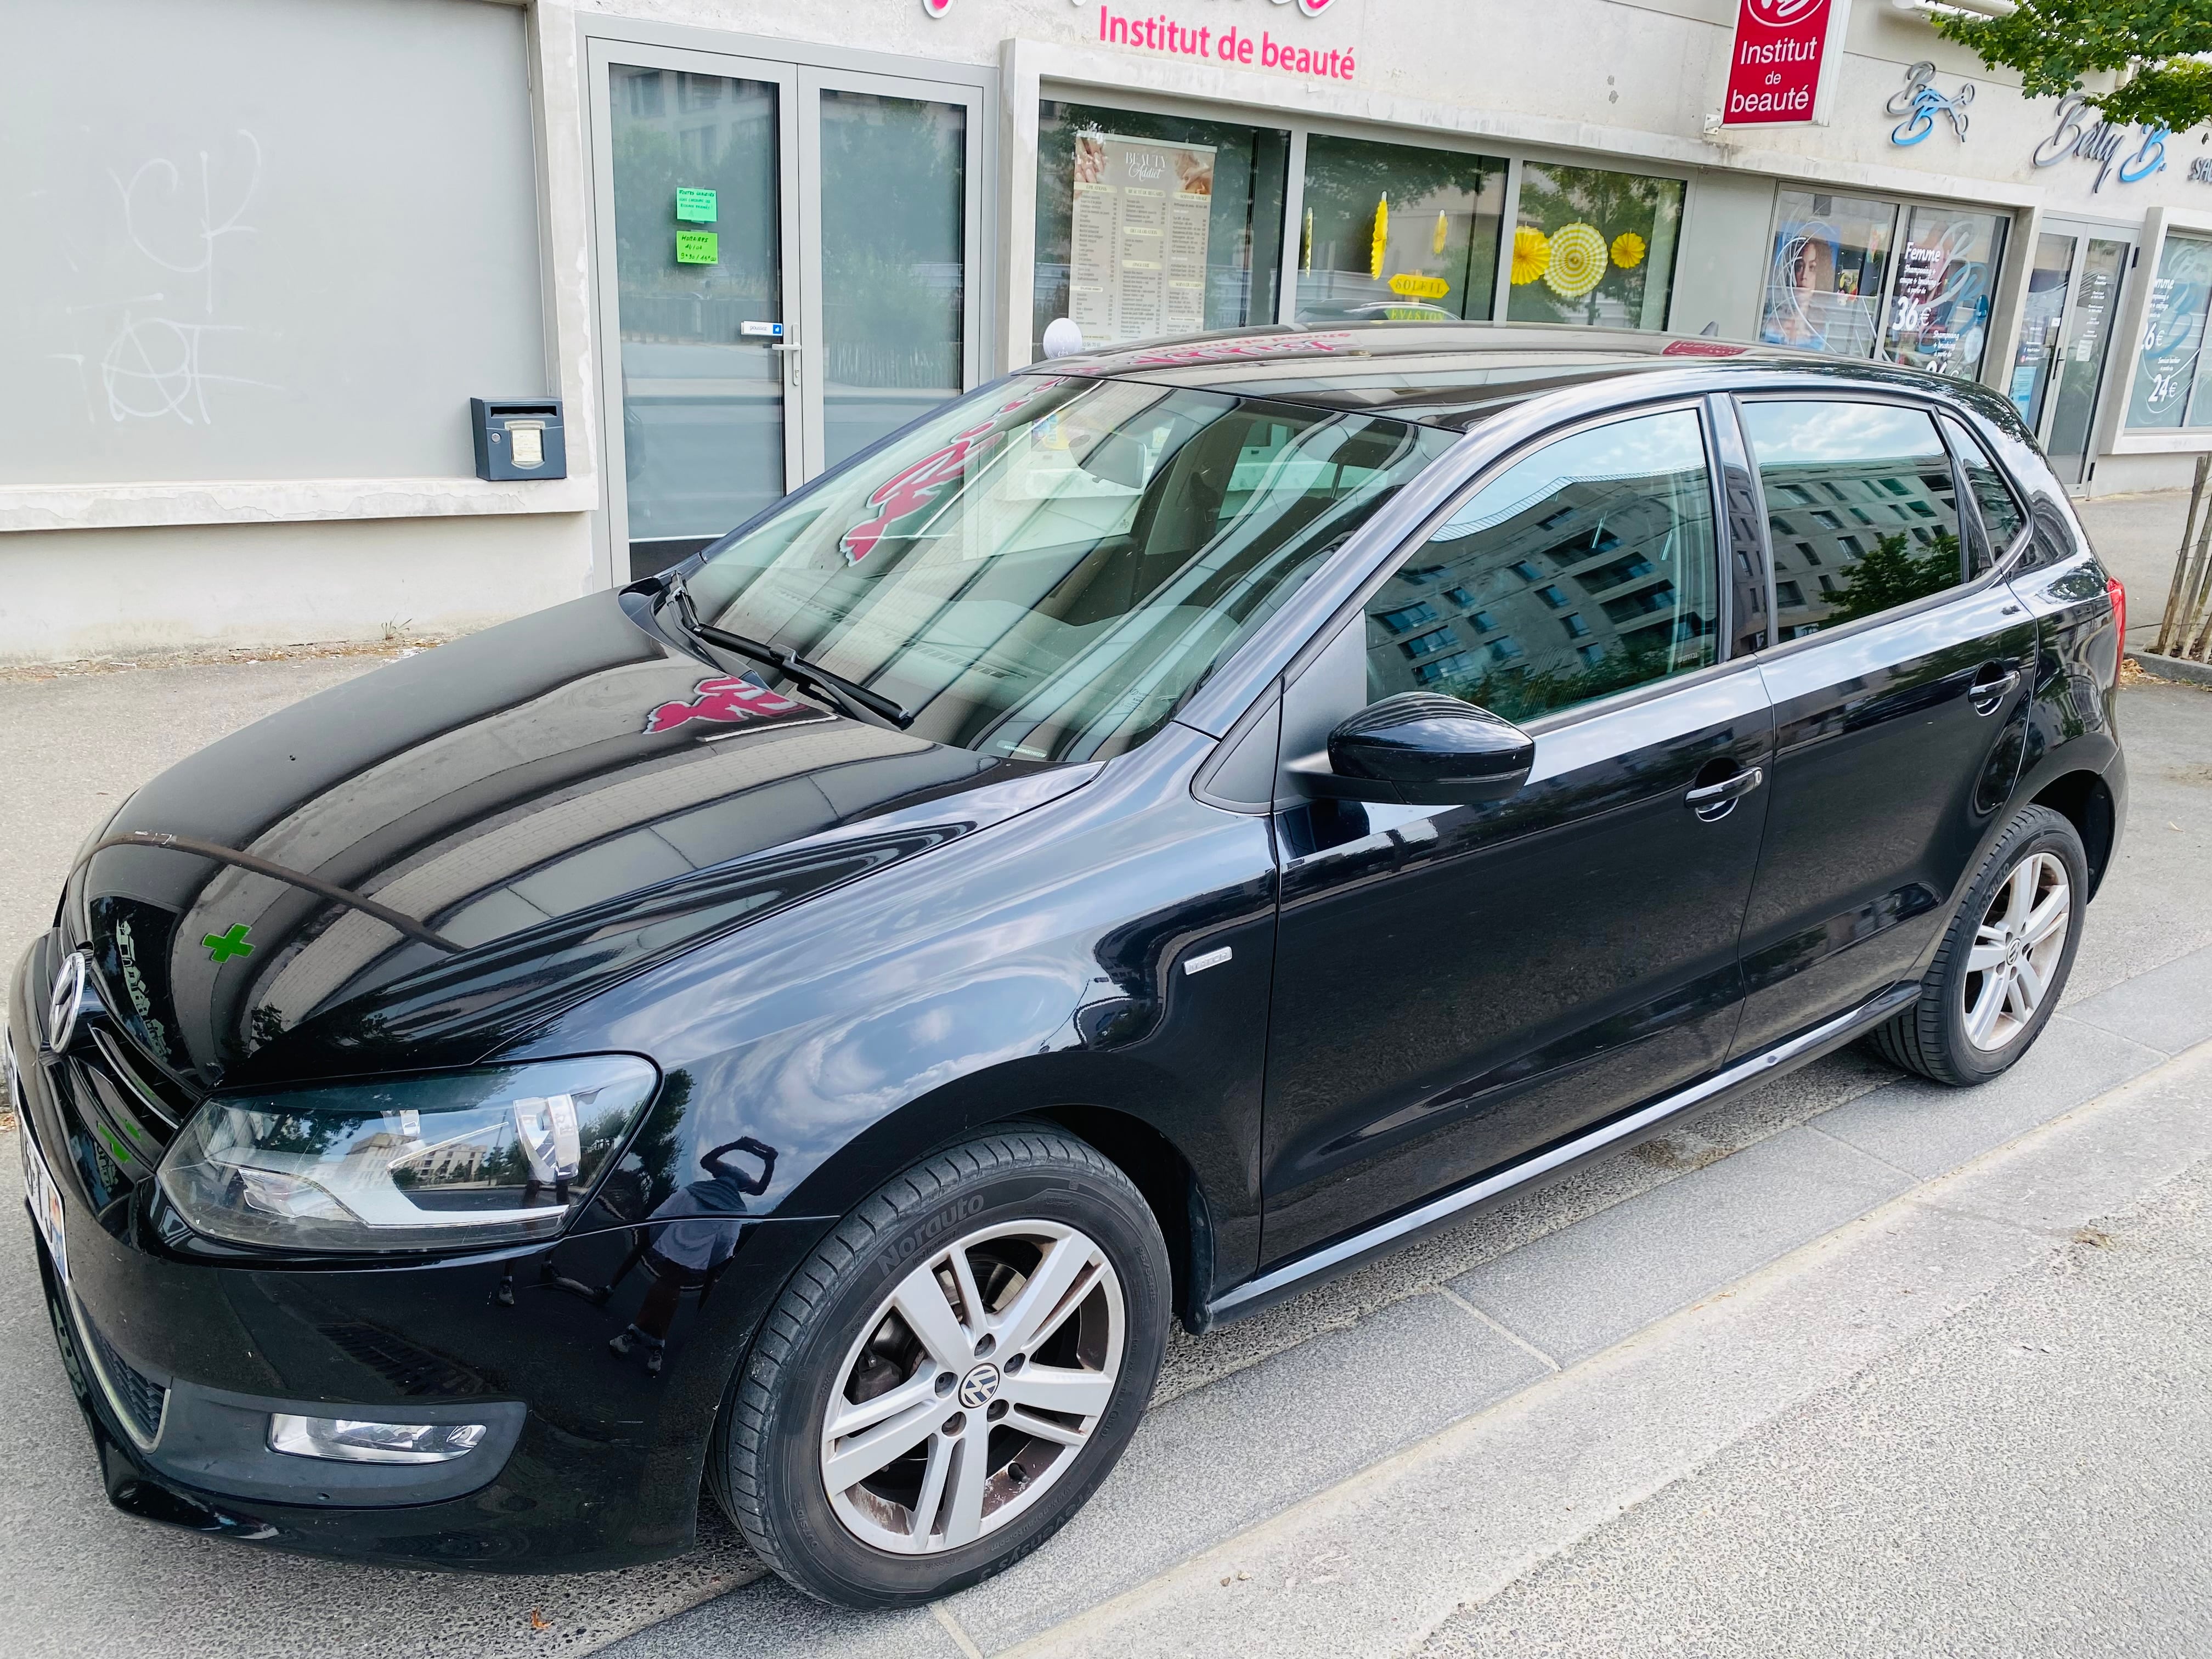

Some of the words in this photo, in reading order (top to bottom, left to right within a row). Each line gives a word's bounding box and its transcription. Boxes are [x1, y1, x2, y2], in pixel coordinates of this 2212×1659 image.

[1099, 5, 1210, 57] Institut
[1218, 26, 1252, 64] de
[1261, 31, 1355, 80] beauté
[1740, 37, 1818, 65] Institut
[1765, 71, 1781, 84] de
[1730, 84, 1809, 112] beauté
[1126, 151, 1166, 168] BEAUTY
[1128, 163, 1165, 182] Addict
[1905, 241, 1941, 262] Femme
[1395, 278, 1443, 294] SOLEIL
[878, 1194, 984, 1277] Norauto
